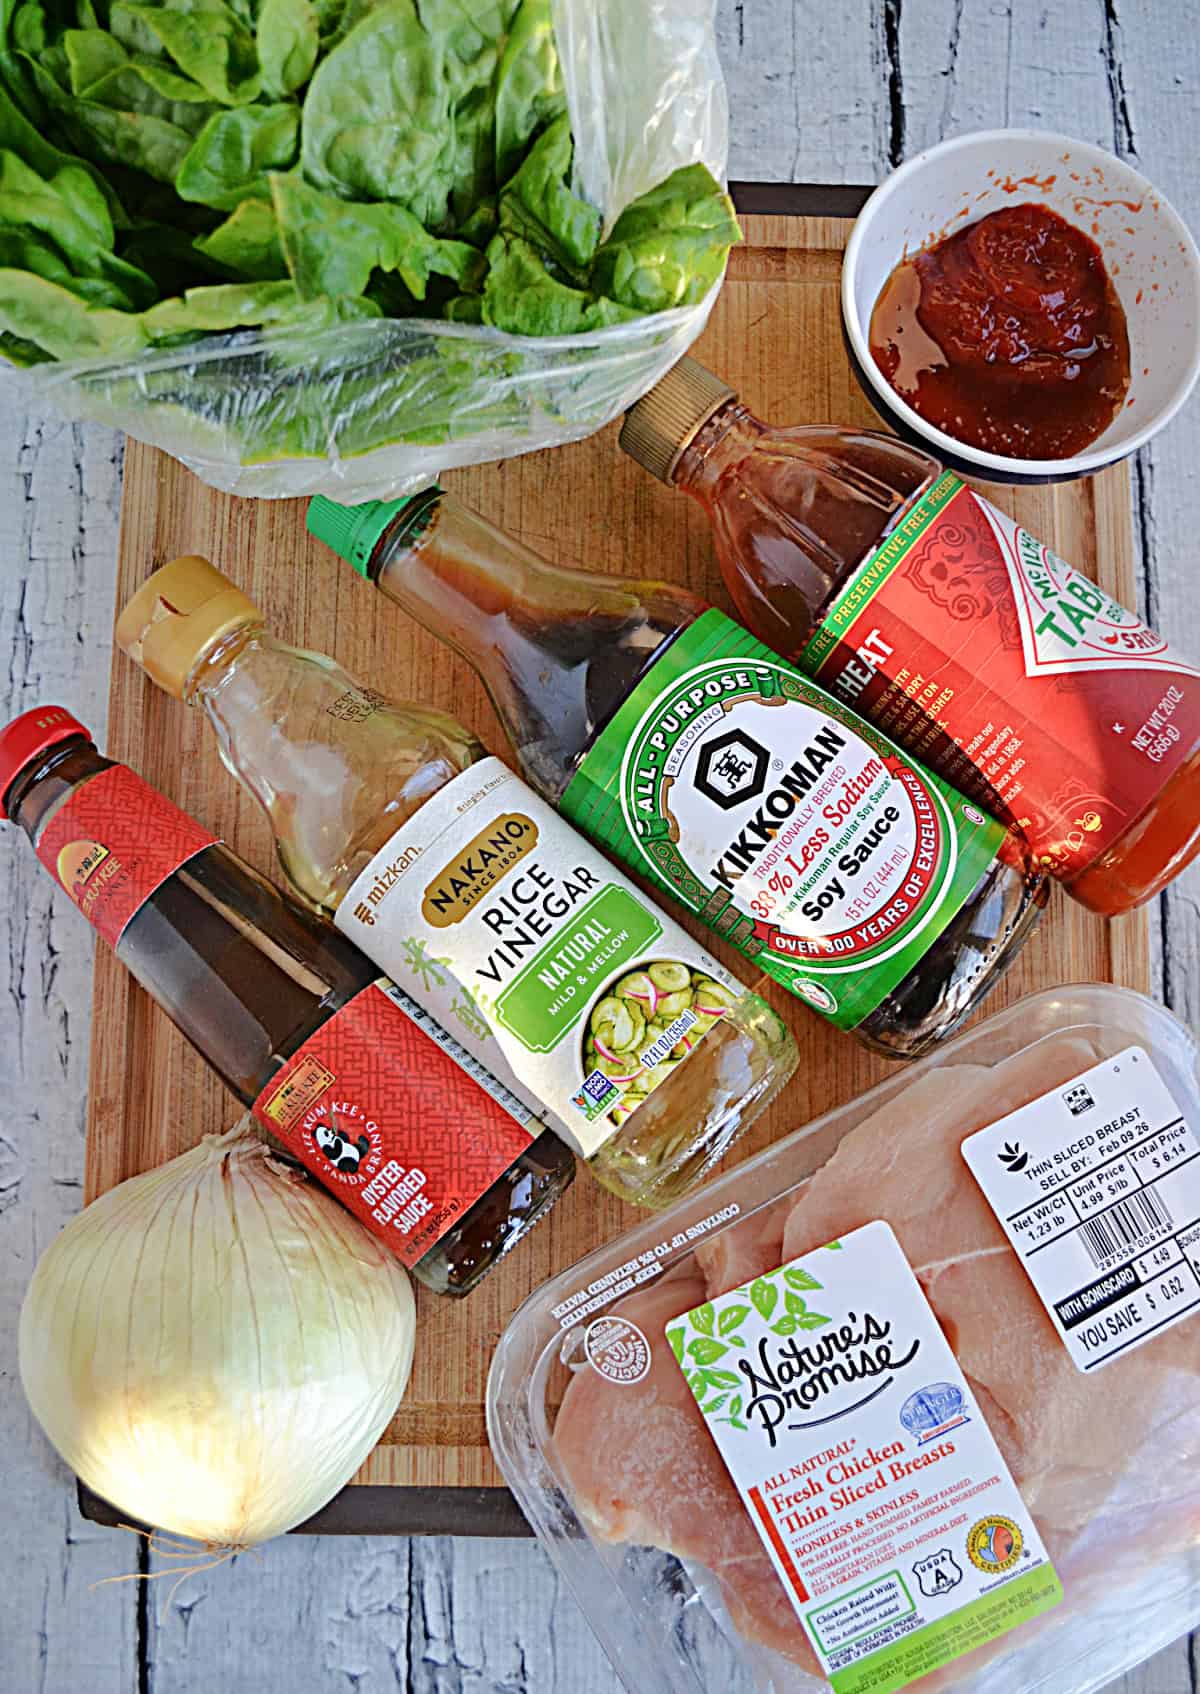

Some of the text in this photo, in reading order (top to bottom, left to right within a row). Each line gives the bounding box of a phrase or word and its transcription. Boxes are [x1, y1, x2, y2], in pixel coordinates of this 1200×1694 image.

[832, 534, 907, 625] PRESERVATIVE
[901, 505, 930, 537] FREE
[834, 626, 898, 699] HEAT
[887, 667, 911, 694] WITH
[895, 672, 926, 709] SAVORY
[922, 680, 939, 699] ON
[925, 685, 954, 721] DISHES
[980, 721, 995, 737] our
[666, 707, 722, 773] SEASONING
[981, 723, 1014, 760] legendary
[1129, 724, 1156, 752] NET
[1144, 731, 1174, 764] (566
[709, 725, 847, 889] KIKKOMAN
[752, 763, 847, 881] TRADITIONALLY BREWED
[780, 820, 829, 876] Less
[819, 753, 883, 829] Sodium
[901, 769, 938, 871] EXCELLENCE
[98, 856, 122, 881] KEE
[462, 844, 523, 905] SINCE 1804
[792, 854, 832, 902] Kikkoman
[827, 817, 862, 858] Regular
[855, 800, 876, 822] Soy
[800, 803, 902, 923] Soy Sauce
[481, 861, 555, 935] RICE
[842, 841, 912, 923] 15 FL OZ (444 mL)
[904, 872, 926, 899] OF
[474, 863, 600, 982] VINEGAR
[775, 935, 819, 954] OVER
[856, 896, 910, 942] YEARS
[536, 914, 612, 991] NATURAL
[547, 929, 630, 1015] MILD & MELLOW
[584, 1073, 601, 1090] NON
[589, 1077, 607, 1095] GMO
[640, 1053, 656, 1070] 12
[301, 1103, 327, 1130] KUM
[332, 1101, 357, 1117] KEE
[303, 1131, 315, 1152] LEE
[365, 1118, 382, 1174] BRAND
[1023, 1106, 1143, 1181] THIN SLICED BREAST
[1038, 1120, 1150, 1191] SELL BY: Feb 09 26
[358, 1157, 406, 1207] OYSTER
[371, 1166, 428, 1226] FLAVORED
[1011, 1123, 1186, 1233] Net Wt/Ct Unit Price Total Price
[1026, 1142, 1186, 1241] 1.23 lb 4.99 $/lb $ 6.14
[391, 1191, 434, 1235] SAUCE
[550, 1201, 741, 1319] CONTAINS UP TO RETAINED WATER
[631, 1260, 663, 1285] KEEP
[1057, 1246, 1172, 1321] WITH BONUSCARD $ 4.49
[557, 1275, 636, 1328] REFRIGERATED
[1076, 1274, 1186, 1352] YOU SAVE $ 0.62
[737, 1311, 890, 1398] Nature's
[747, 1338, 919, 1448] Promise
[761, 1470, 789, 1493] ALL
[769, 1435, 905, 1514] Fresh Chicken
[778, 1438, 956, 1535] Thin Sliced Breasts
[793, 1488, 920, 1558] BONELESS & SKINLESS
[918, 1554, 948, 1573] USDA
[930, 1566, 948, 1584] A
[815, 1603, 848, 1625] Chicken
[847, 1590, 874, 1608] Raised
